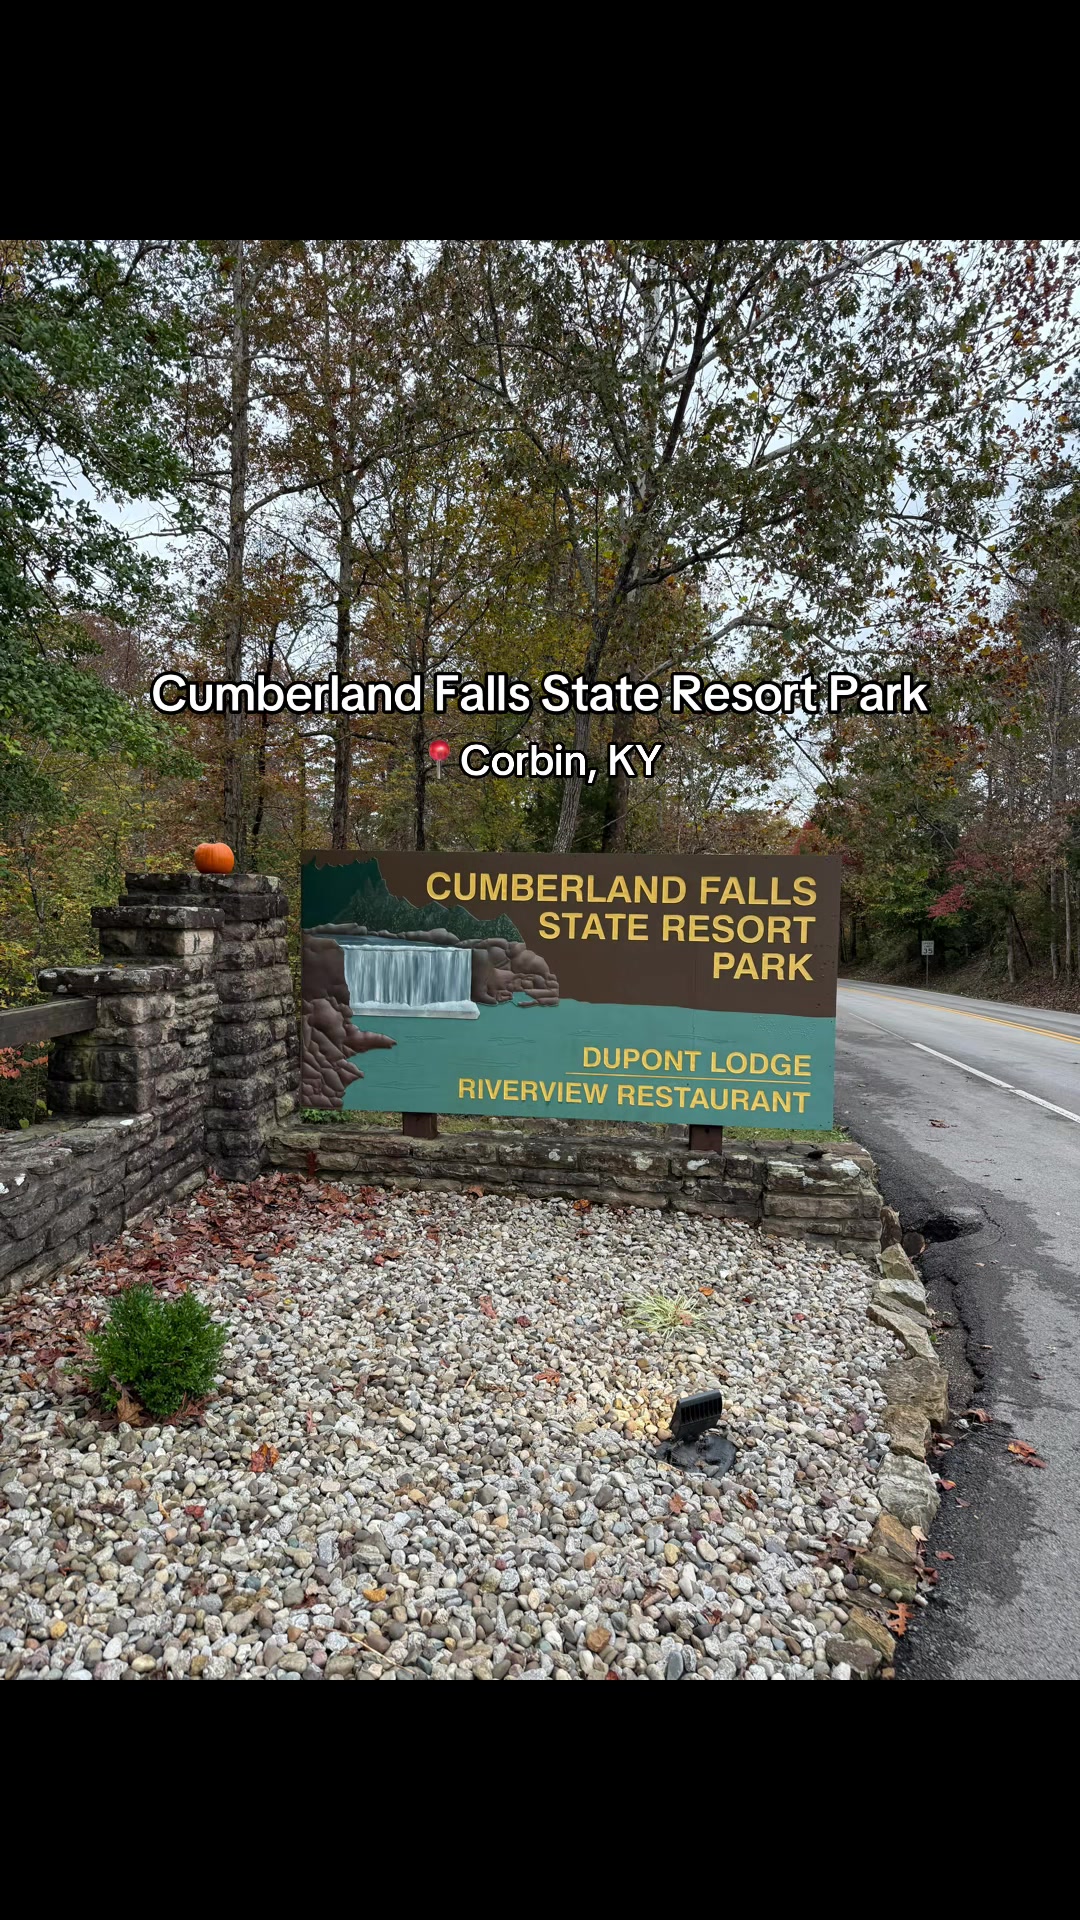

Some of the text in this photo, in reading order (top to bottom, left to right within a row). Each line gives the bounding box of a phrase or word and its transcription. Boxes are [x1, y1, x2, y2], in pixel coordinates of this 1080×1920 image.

[426, 871, 818, 907] CUMBERLAND FALLS
[539, 911, 817, 945] STATE RESORT
[713, 951, 813, 982] PARK
[582, 1046, 812, 1077] DUPONT LODGE
[458, 1078, 811, 1114] RIVERVIEW RESTAURANT
